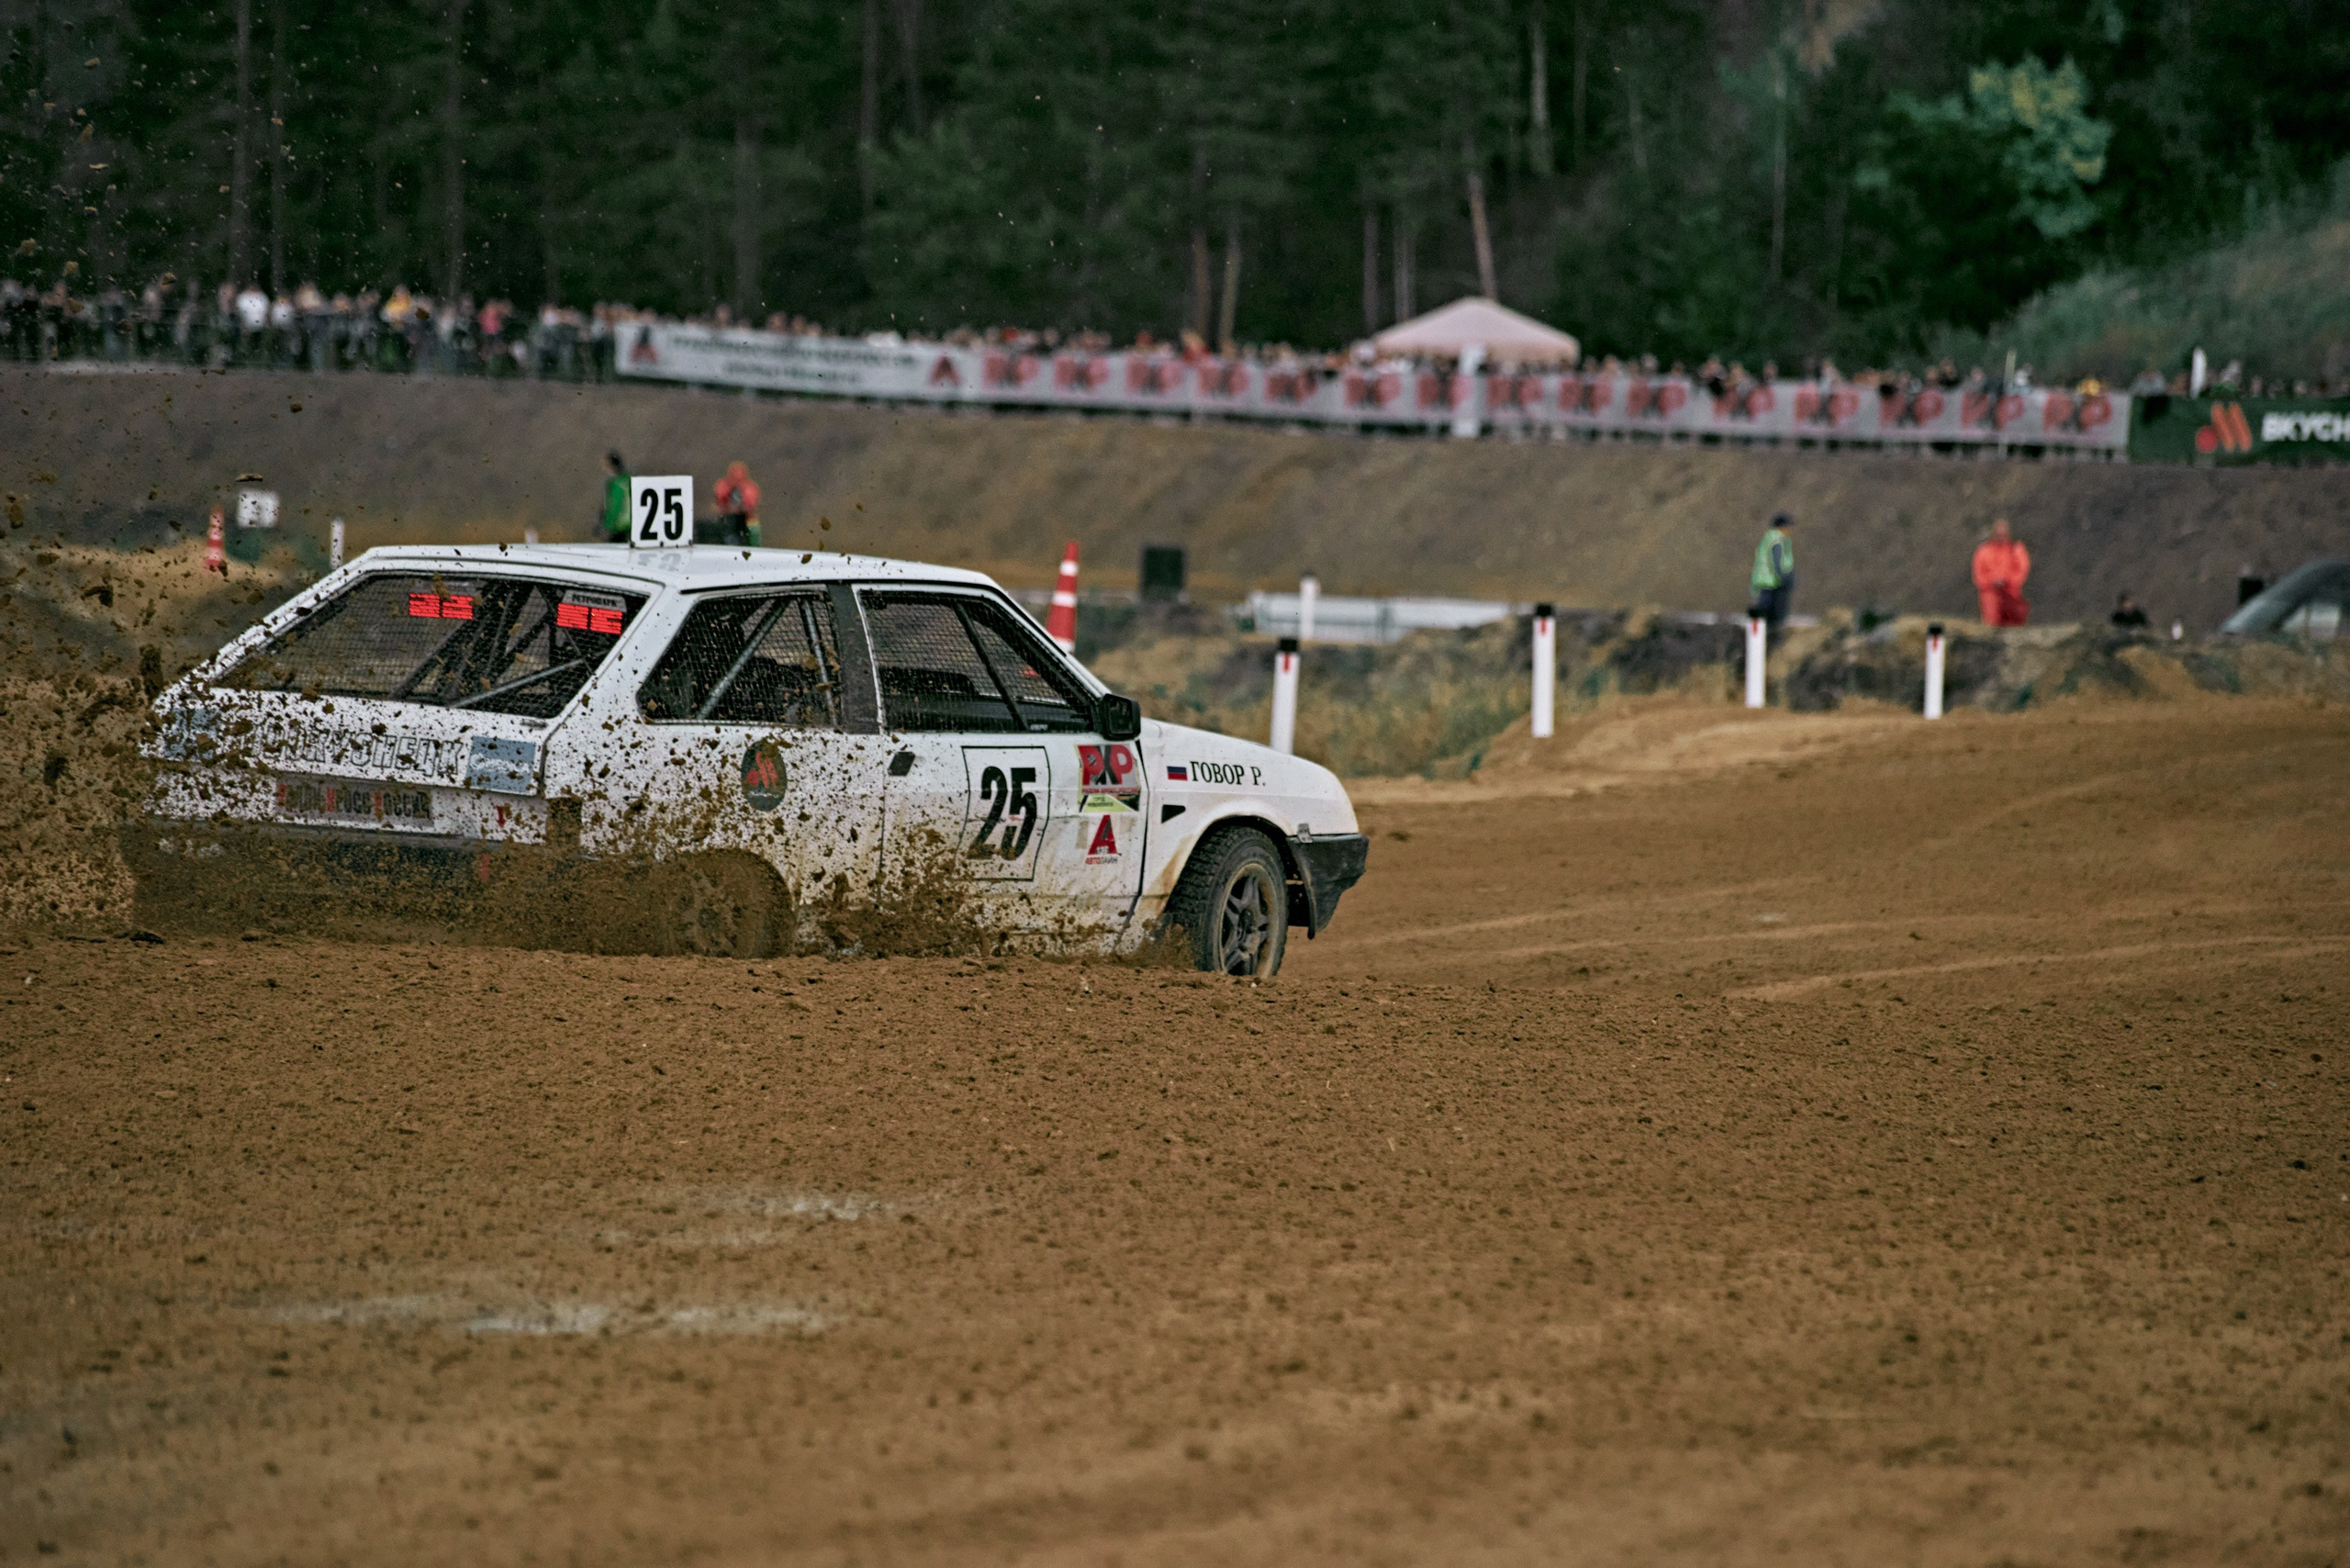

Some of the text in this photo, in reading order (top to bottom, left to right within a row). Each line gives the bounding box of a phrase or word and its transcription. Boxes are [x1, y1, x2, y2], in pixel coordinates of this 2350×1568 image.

[640, 488, 683, 540] 25
[1190, 760, 1266, 787] ГОВОР Р.
[966, 766, 1037, 861] 25
